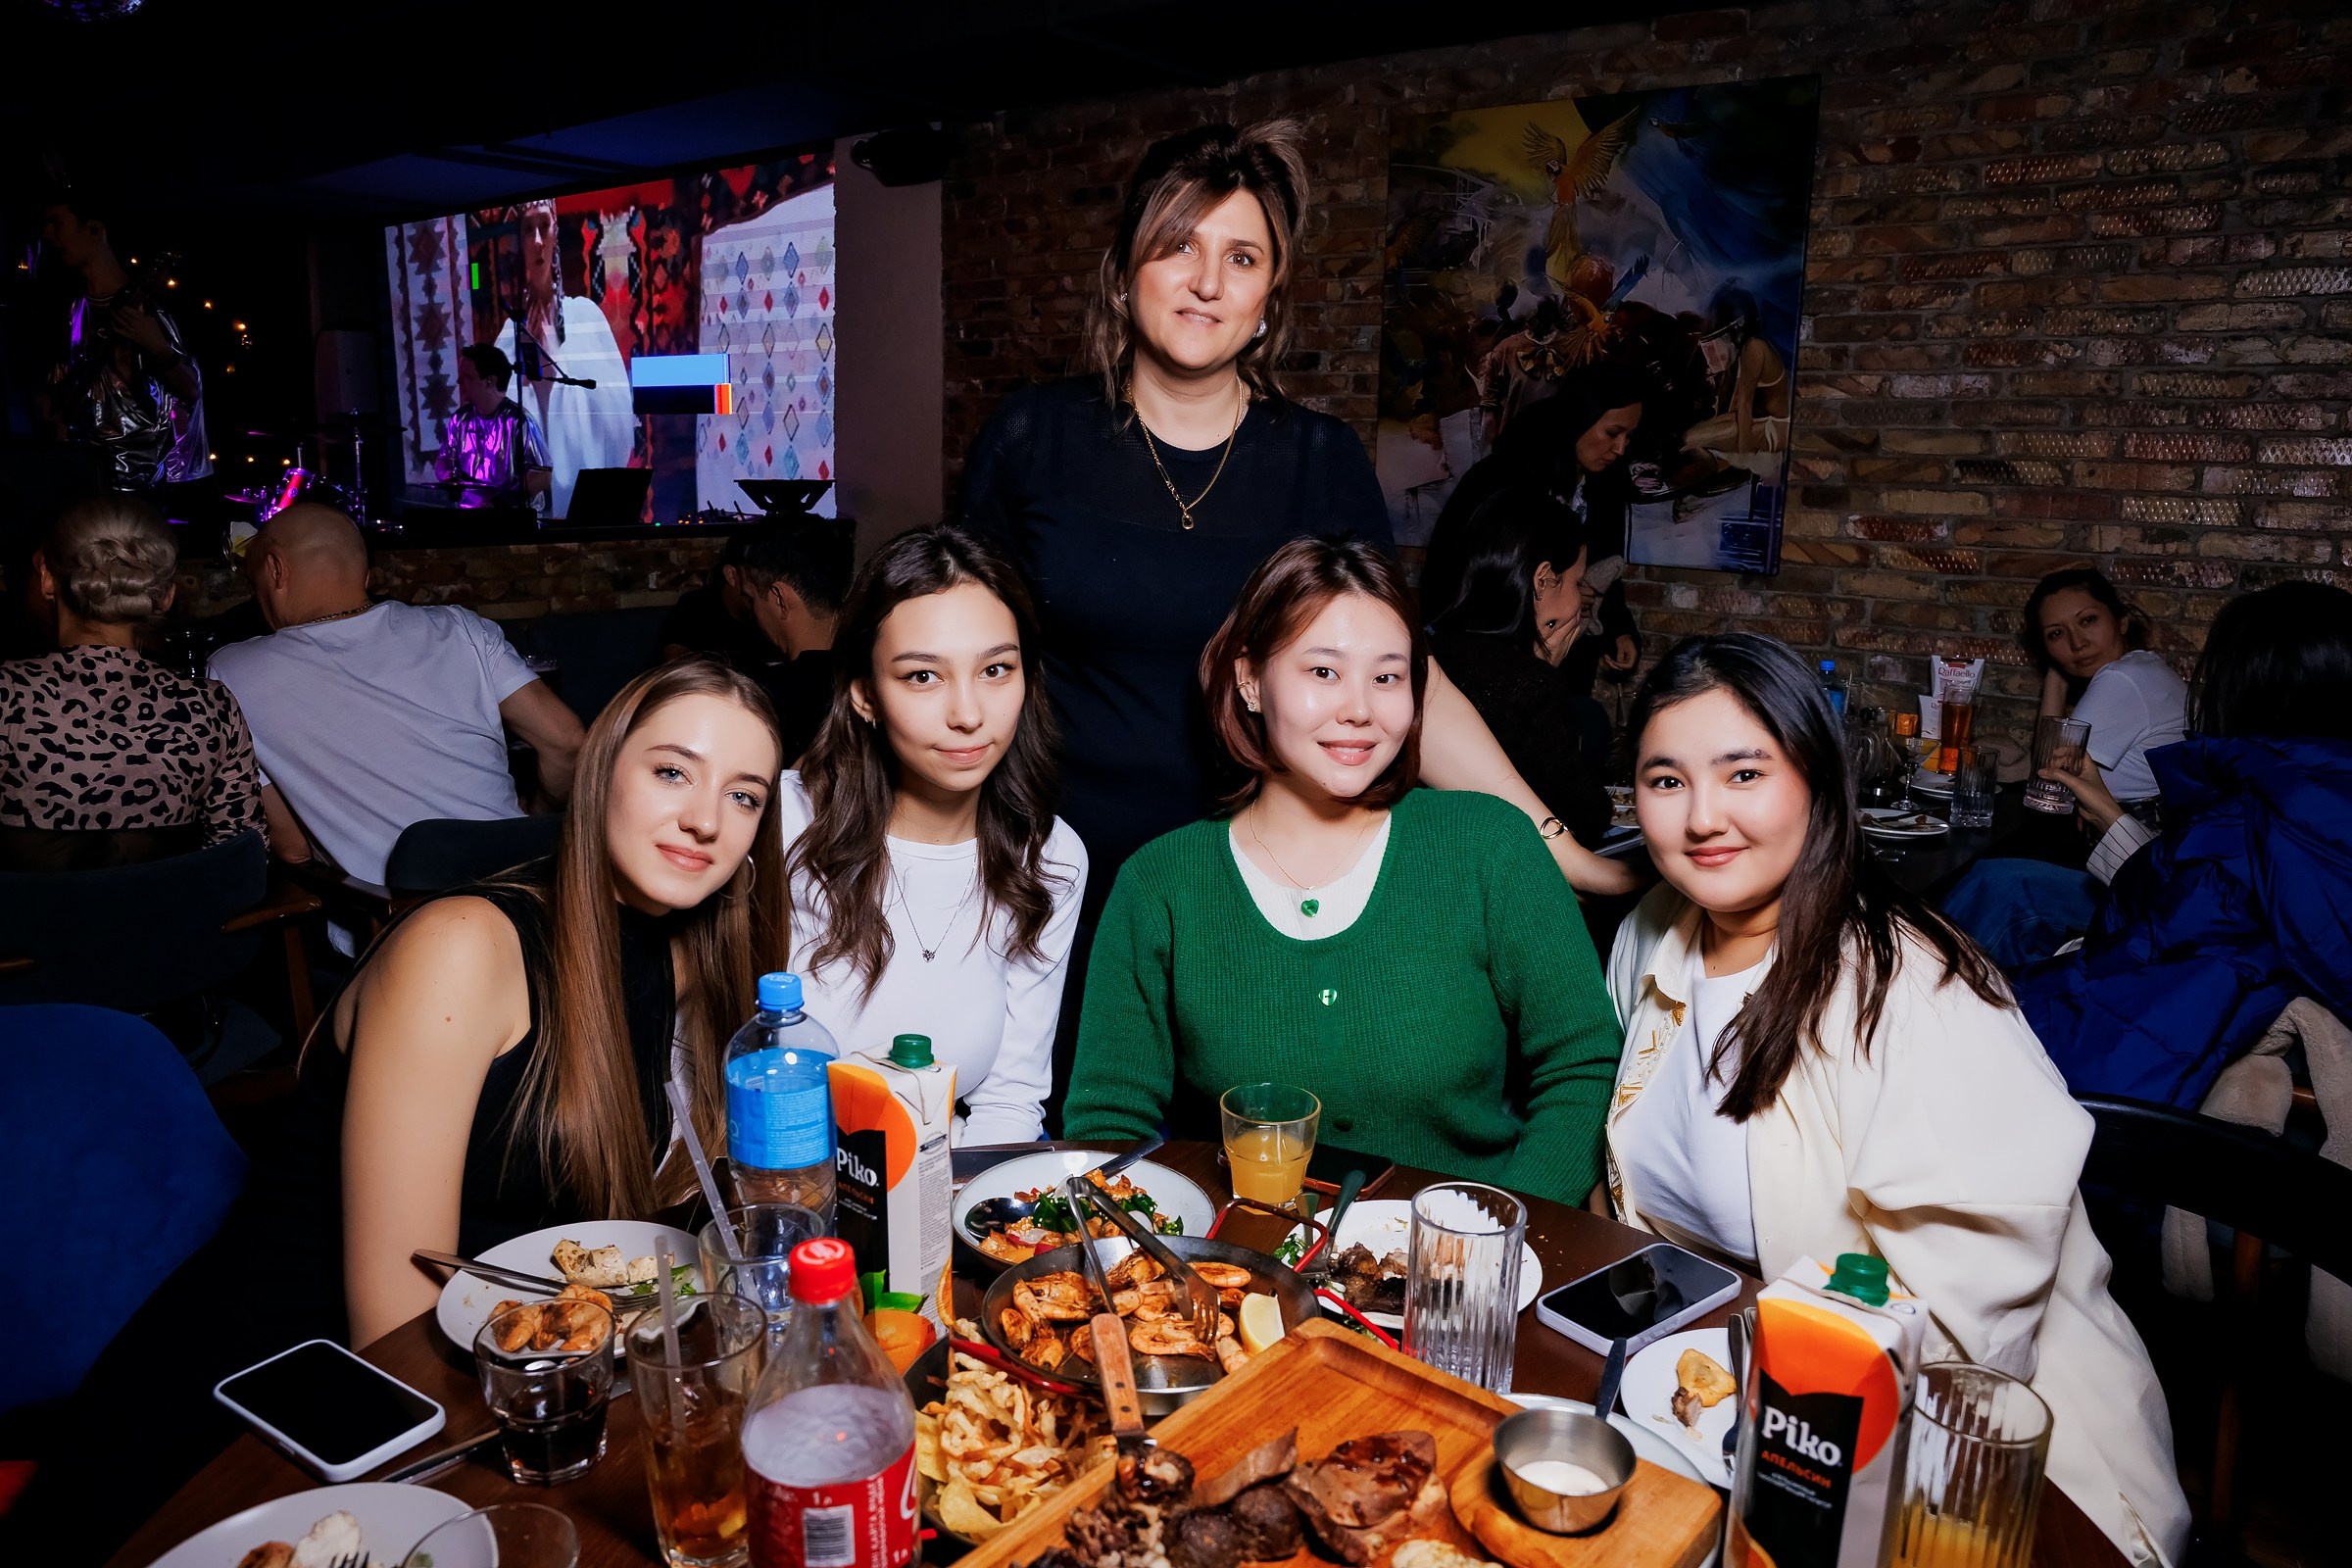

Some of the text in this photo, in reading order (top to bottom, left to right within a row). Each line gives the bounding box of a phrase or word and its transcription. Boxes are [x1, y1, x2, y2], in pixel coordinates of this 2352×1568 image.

[1937, 666, 1976, 678] Raffaello
[837, 1147, 878, 1187] Piko
[1761, 1404, 1841, 1466] Piko
[1761, 1450, 1832, 1489] АПЕЛЬСИН
